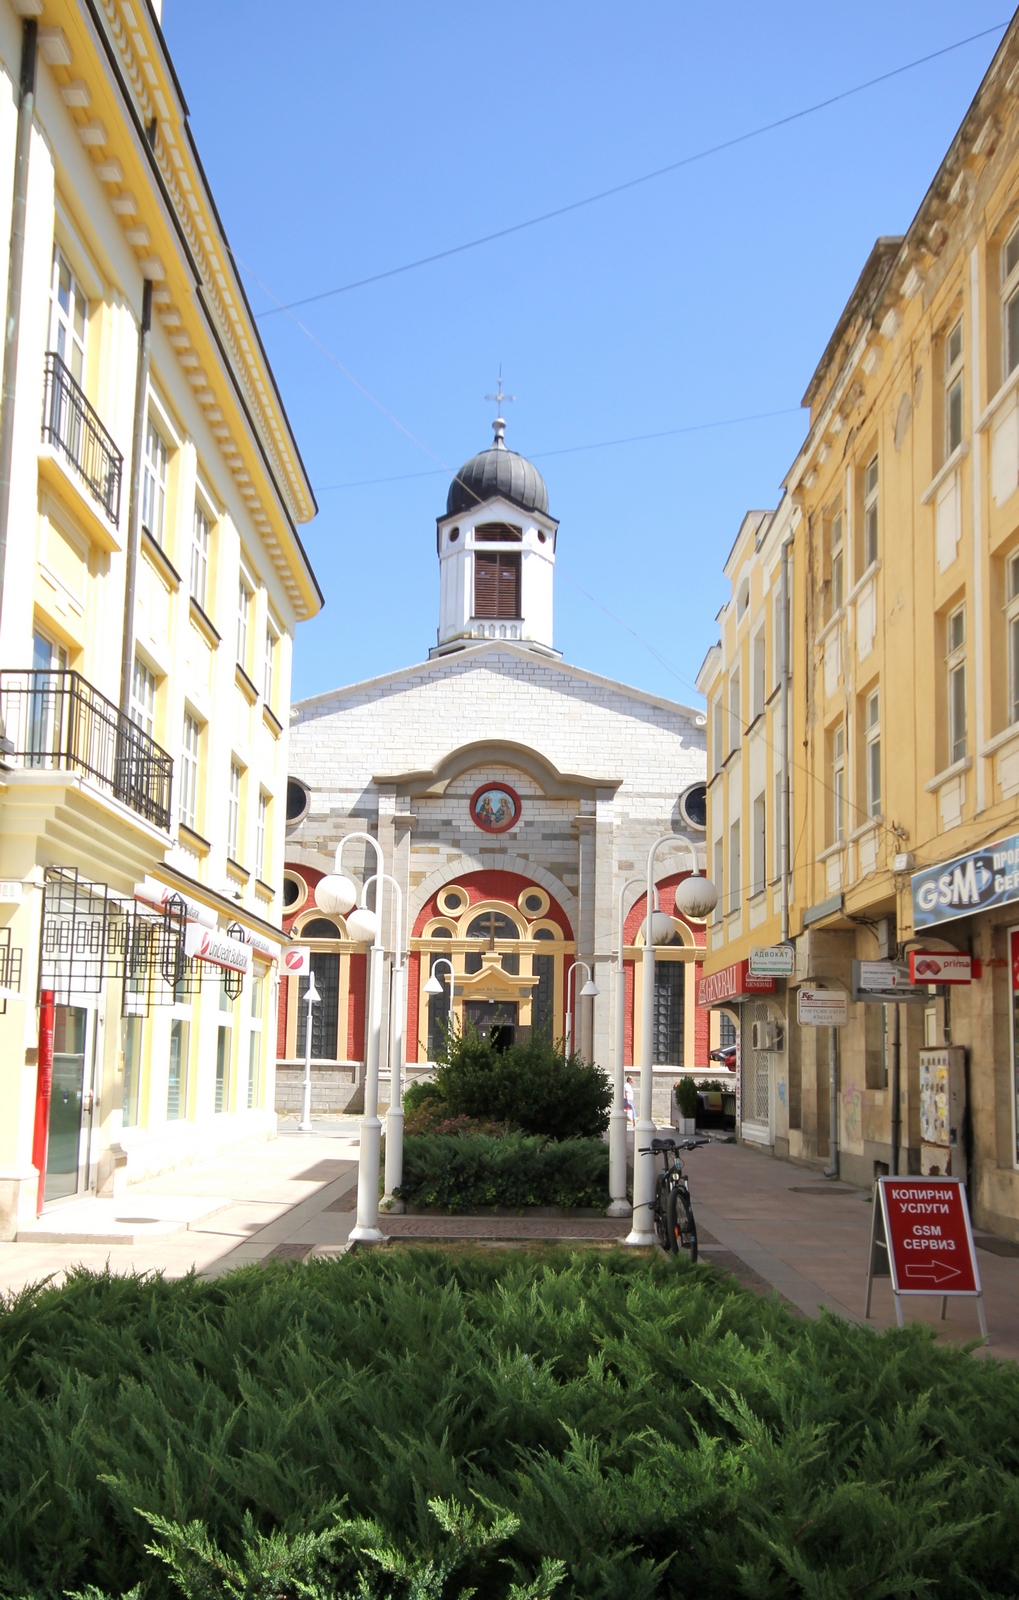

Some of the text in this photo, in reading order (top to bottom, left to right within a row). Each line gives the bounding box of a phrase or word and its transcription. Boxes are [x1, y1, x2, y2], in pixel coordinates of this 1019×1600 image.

[919, 858, 980, 911] GSM
[209, 939, 248, 968] UniCredit Bulbank
[943, 959, 970, 969] prima
[706, 965, 737, 1002] GENERALI
[892, 1189, 953, 1199] КОПИРНИ
[900, 1203, 949, 1213] УСЛУГИ
[913, 1225, 941, 1235] GSM
[904, 1239, 955, 1249] СЕРВИЗ
